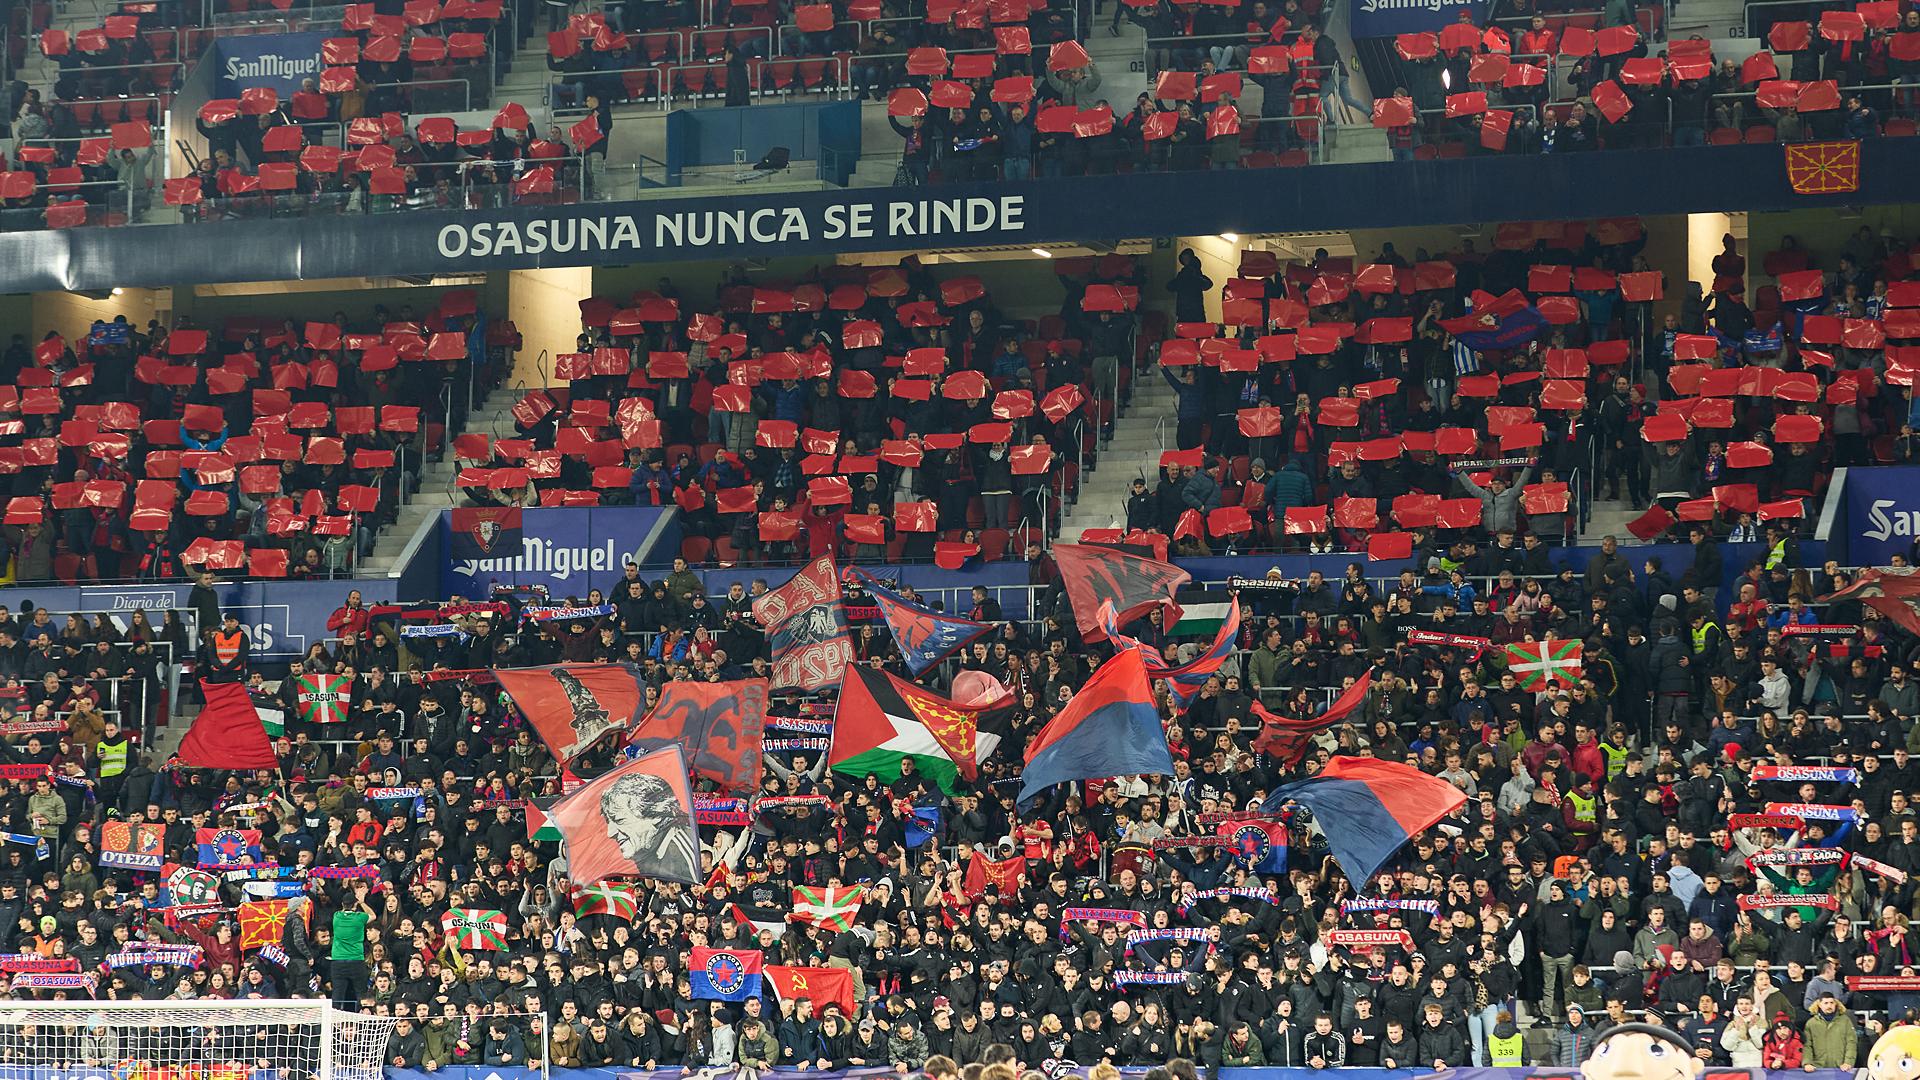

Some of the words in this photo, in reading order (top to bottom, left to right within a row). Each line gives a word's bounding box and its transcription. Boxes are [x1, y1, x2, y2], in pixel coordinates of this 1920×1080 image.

[437, 216, 641, 258] OSASUNA
[655, 208, 810, 248] NUNCA
[823, 203, 874, 240] SE
[889, 195, 1025, 236] RINDE
[113, 594, 153, 609] Diario
[156, 594, 171, 609] de
[450, 603, 500, 613] OSASUNA
[551, 606, 601, 618] OSASUNA
[776, 718, 828, 734] OSASUNA
[1777, 769, 1836, 780] OSASUNA
[373, 787, 417, 798] OSASUN
[1779, 806, 1840, 819] OSASUNA
[1735, 817, 1796, 826] OSASUNA
[102, 851, 161, 868] OTEIZA
[1756, 853, 1776, 862] THIS
[1777, 853, 1786, 861] IS
[1801, 852, 1811, 861] EL
[1346, 899, 1384, 911] INDAR
[1335, 933, 1401, 942] OSASUNA
[260, 944, 290, 968] INDAR
[7, 961, 62, 970] OSASUNA
[33, 977, 81, 985] OSASUNA
